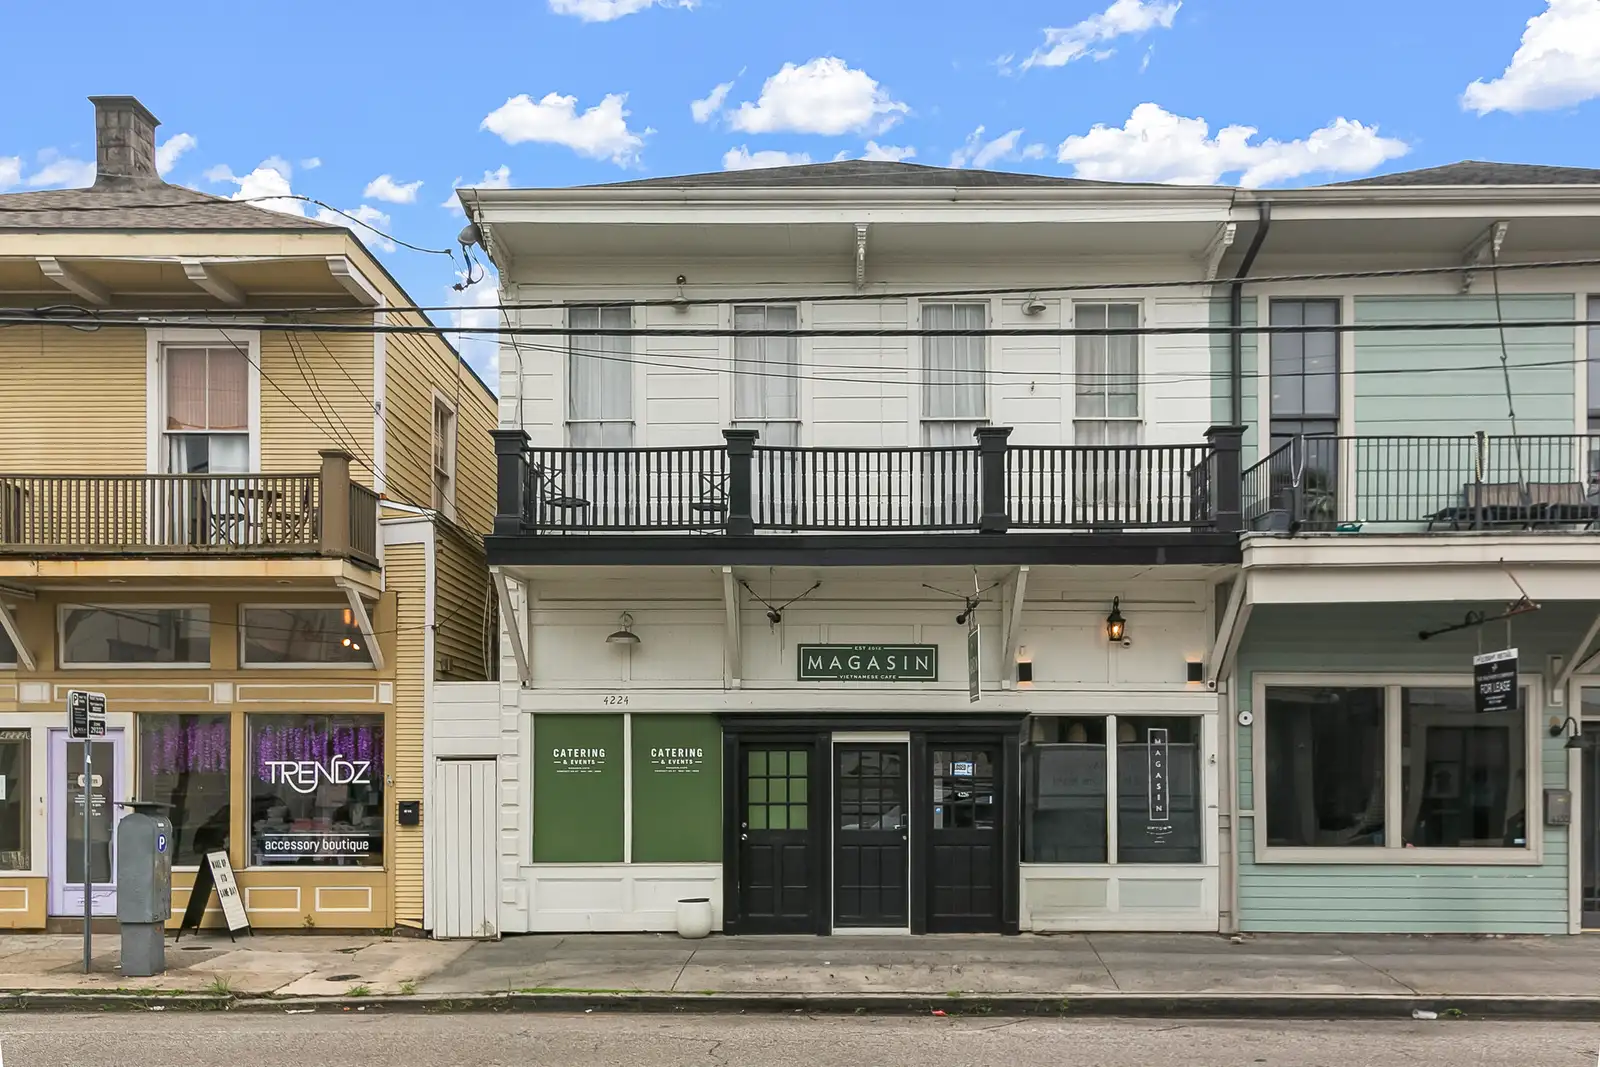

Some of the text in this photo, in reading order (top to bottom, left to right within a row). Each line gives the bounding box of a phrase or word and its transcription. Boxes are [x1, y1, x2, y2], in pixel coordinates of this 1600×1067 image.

[807, 655, 929, 671] MAGASIN
[1480, 680, 1511, 694] FOR LEASE
[603, 695, 629, 705] 4224
[553, 748, 606, 758] CATERING
[651, 748, 703, 758] CATERING
[264, 754, 371, 794] TRENDZ
[1154, 738, 1163, 812] MAGASIN
[264, 838, 370, 852] accessory boutique
